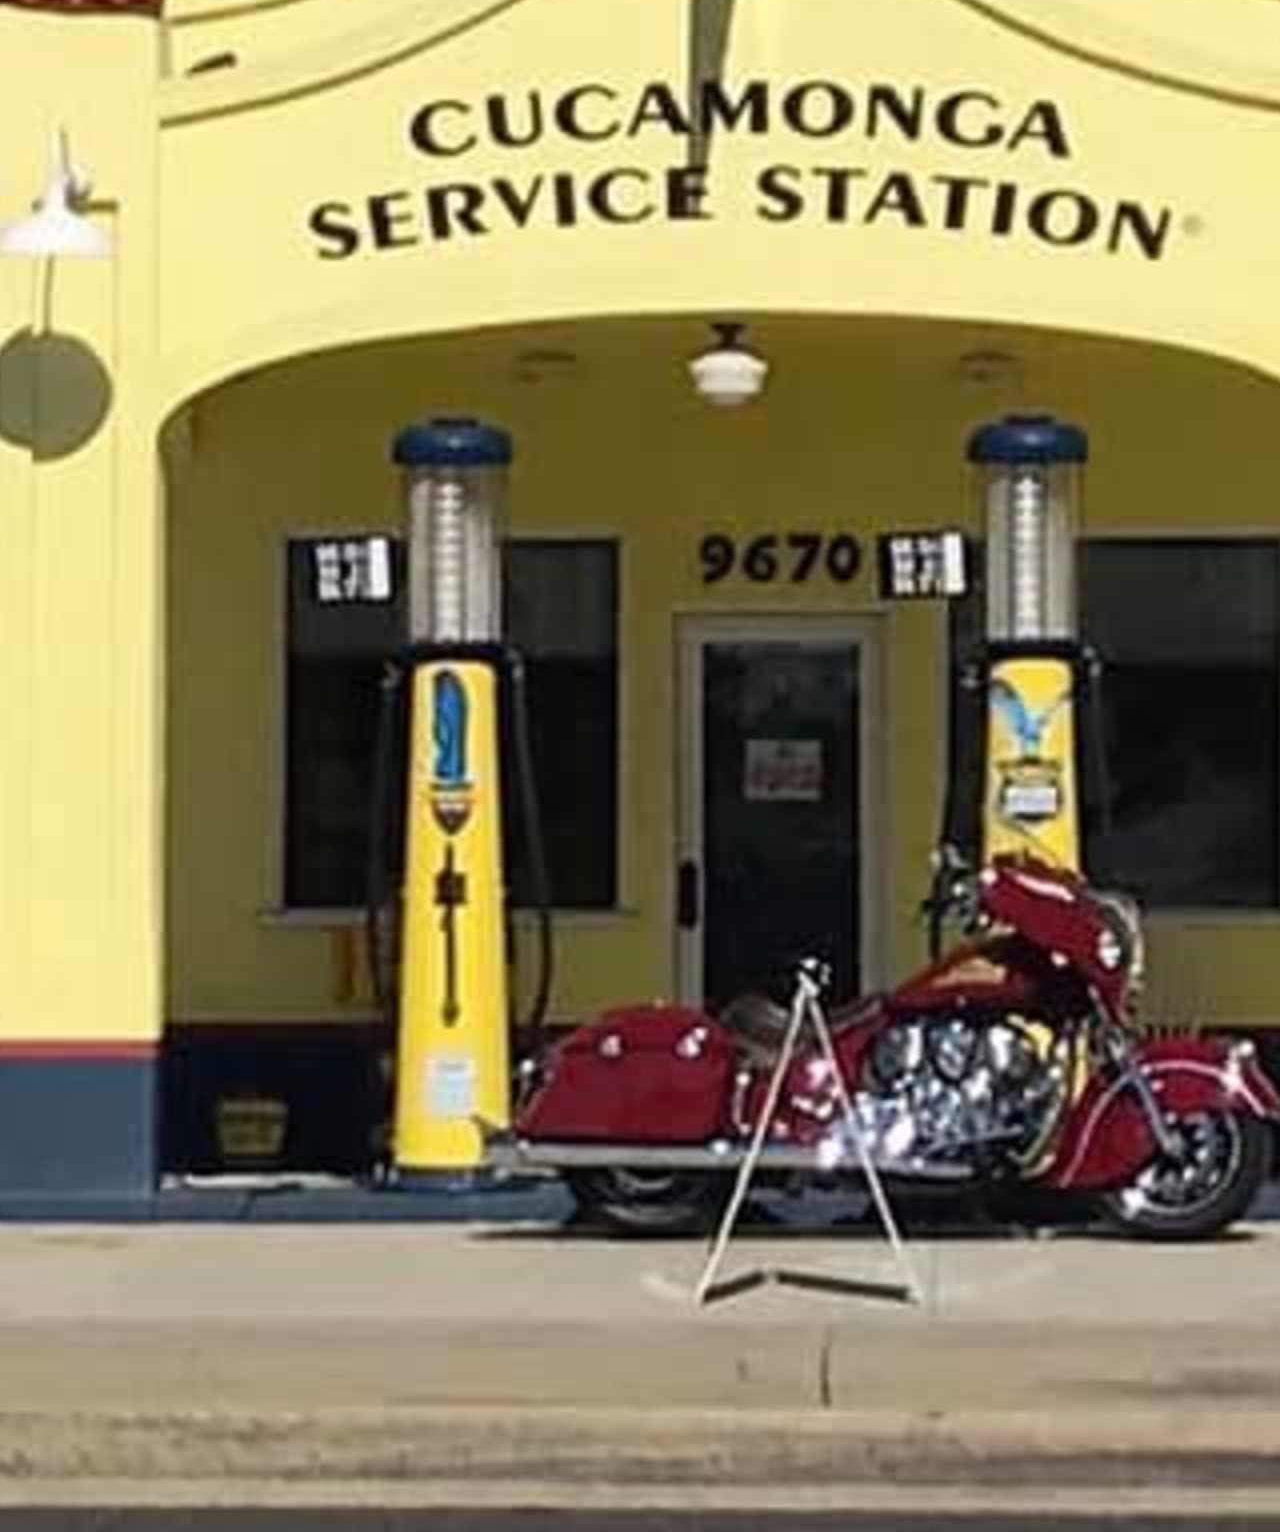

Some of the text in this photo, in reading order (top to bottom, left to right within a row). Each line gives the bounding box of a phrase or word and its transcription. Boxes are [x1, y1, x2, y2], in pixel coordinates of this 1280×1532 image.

[409, 80, 1071, 160] CUCAMONGA
[308, 164, 1173, 261] SERVICE STATION
[699, 534, 861, 585] 9670
